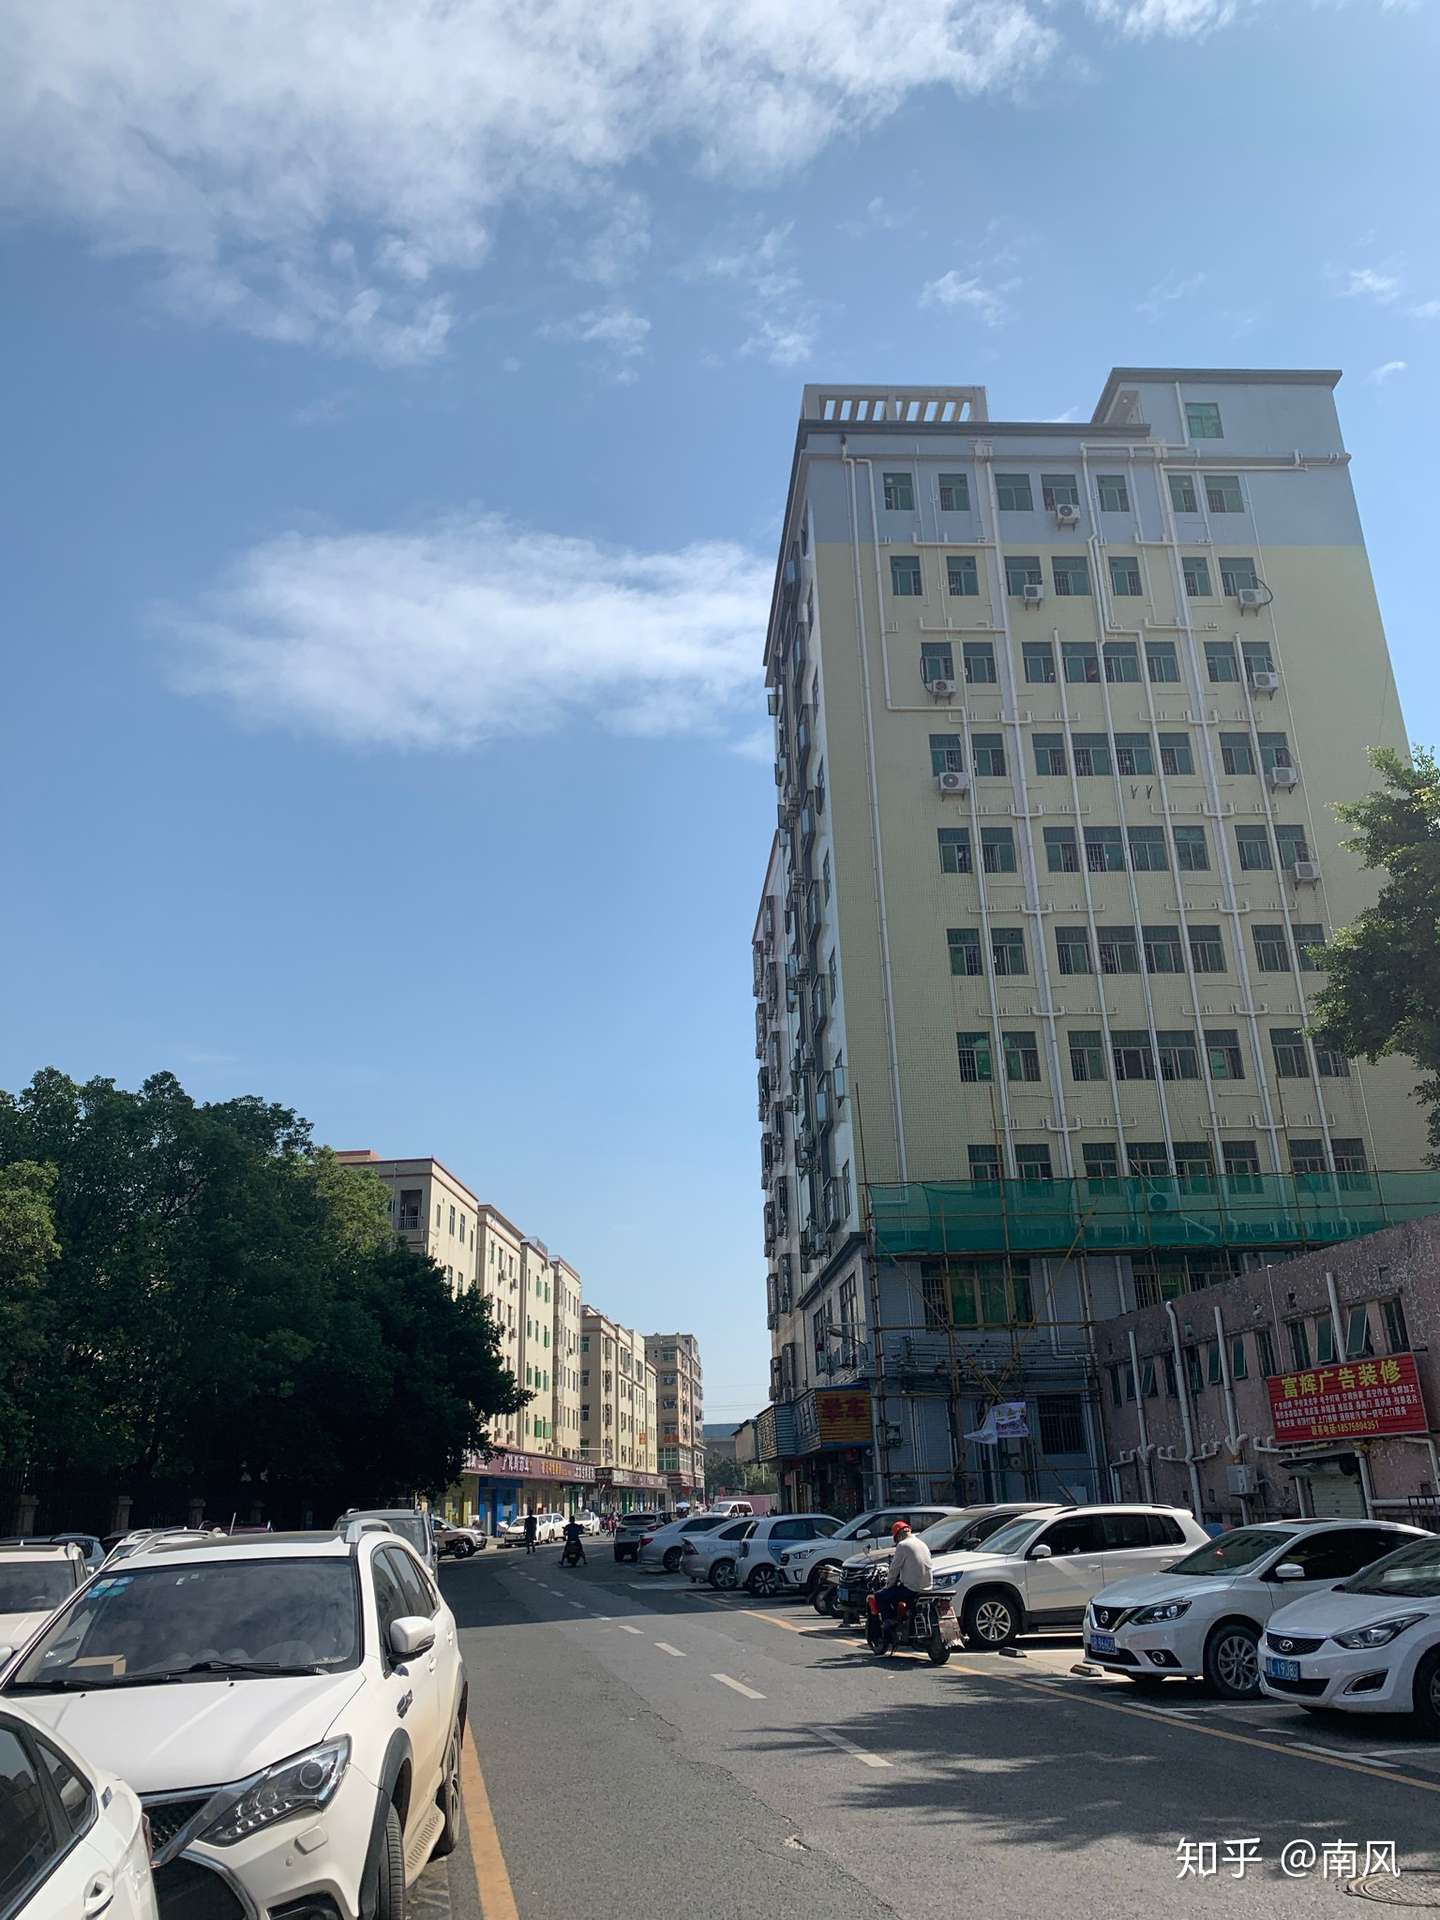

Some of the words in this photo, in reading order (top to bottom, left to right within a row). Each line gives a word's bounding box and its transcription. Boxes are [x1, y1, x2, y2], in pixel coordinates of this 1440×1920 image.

[1281, 1359, 1401, 1398] 富辉广告装修
